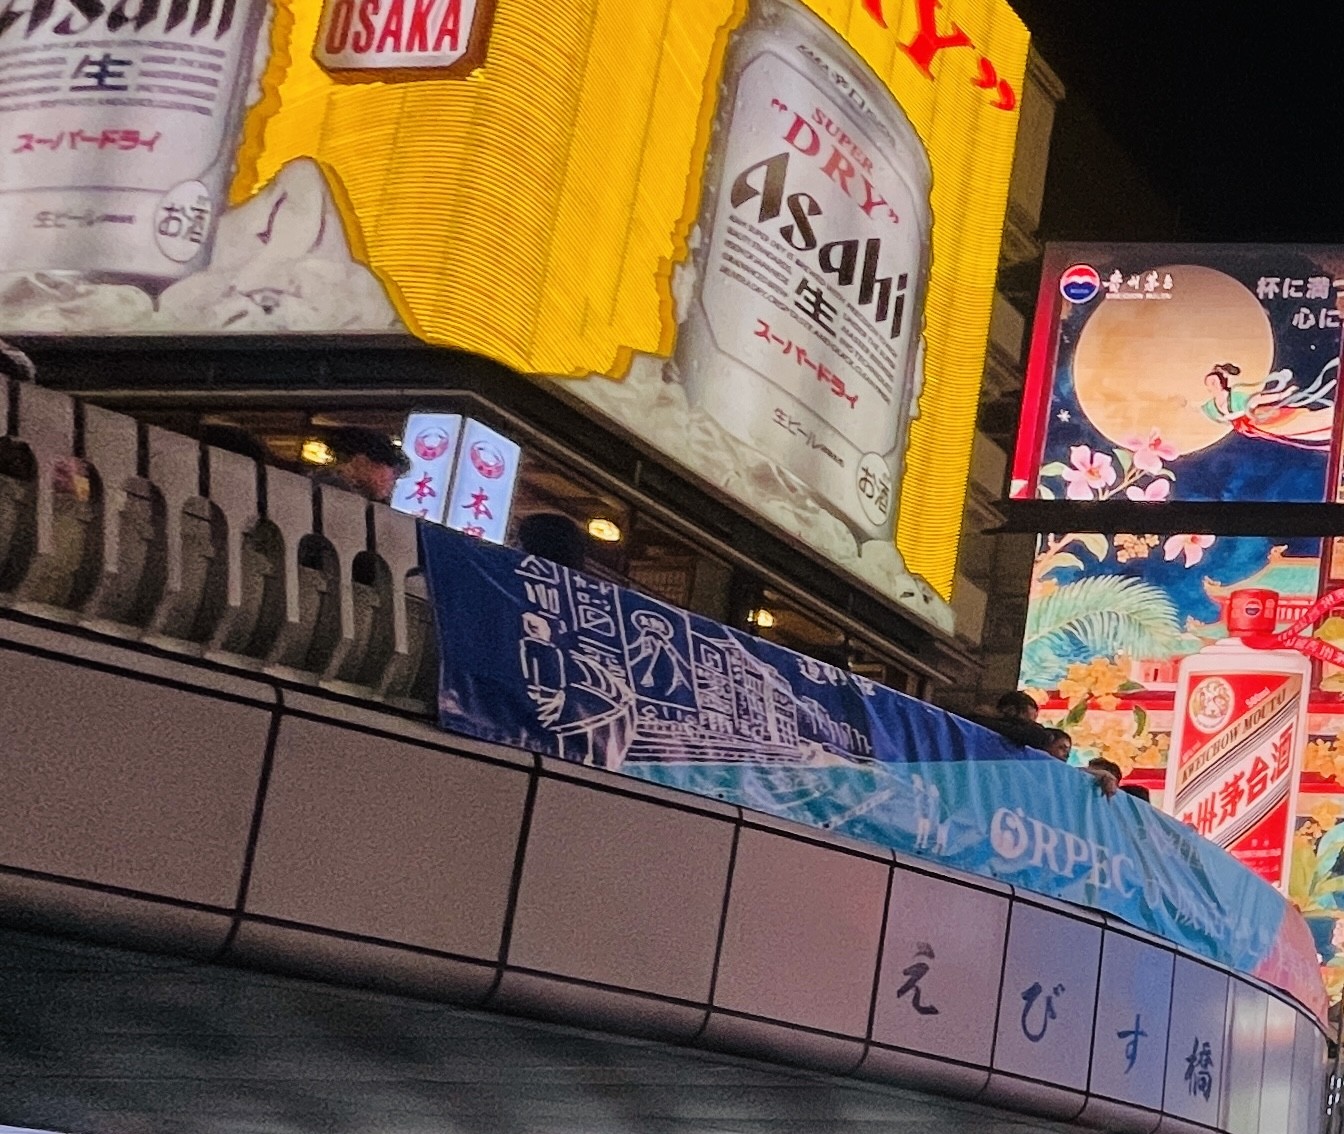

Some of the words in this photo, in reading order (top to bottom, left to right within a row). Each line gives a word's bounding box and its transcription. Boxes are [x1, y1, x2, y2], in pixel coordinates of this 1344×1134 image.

[325, 0, 462, 54] OSAKA
[70, 54, 133, 91] 生
[12, 129, 162, 153] スーパードライ
[812, 107, 875, 173] SUPER
[730, 152, 908, 340] Asahi
[794, 278, 838, 338] 生
[754, 318, 859, 409] スーパードライ
